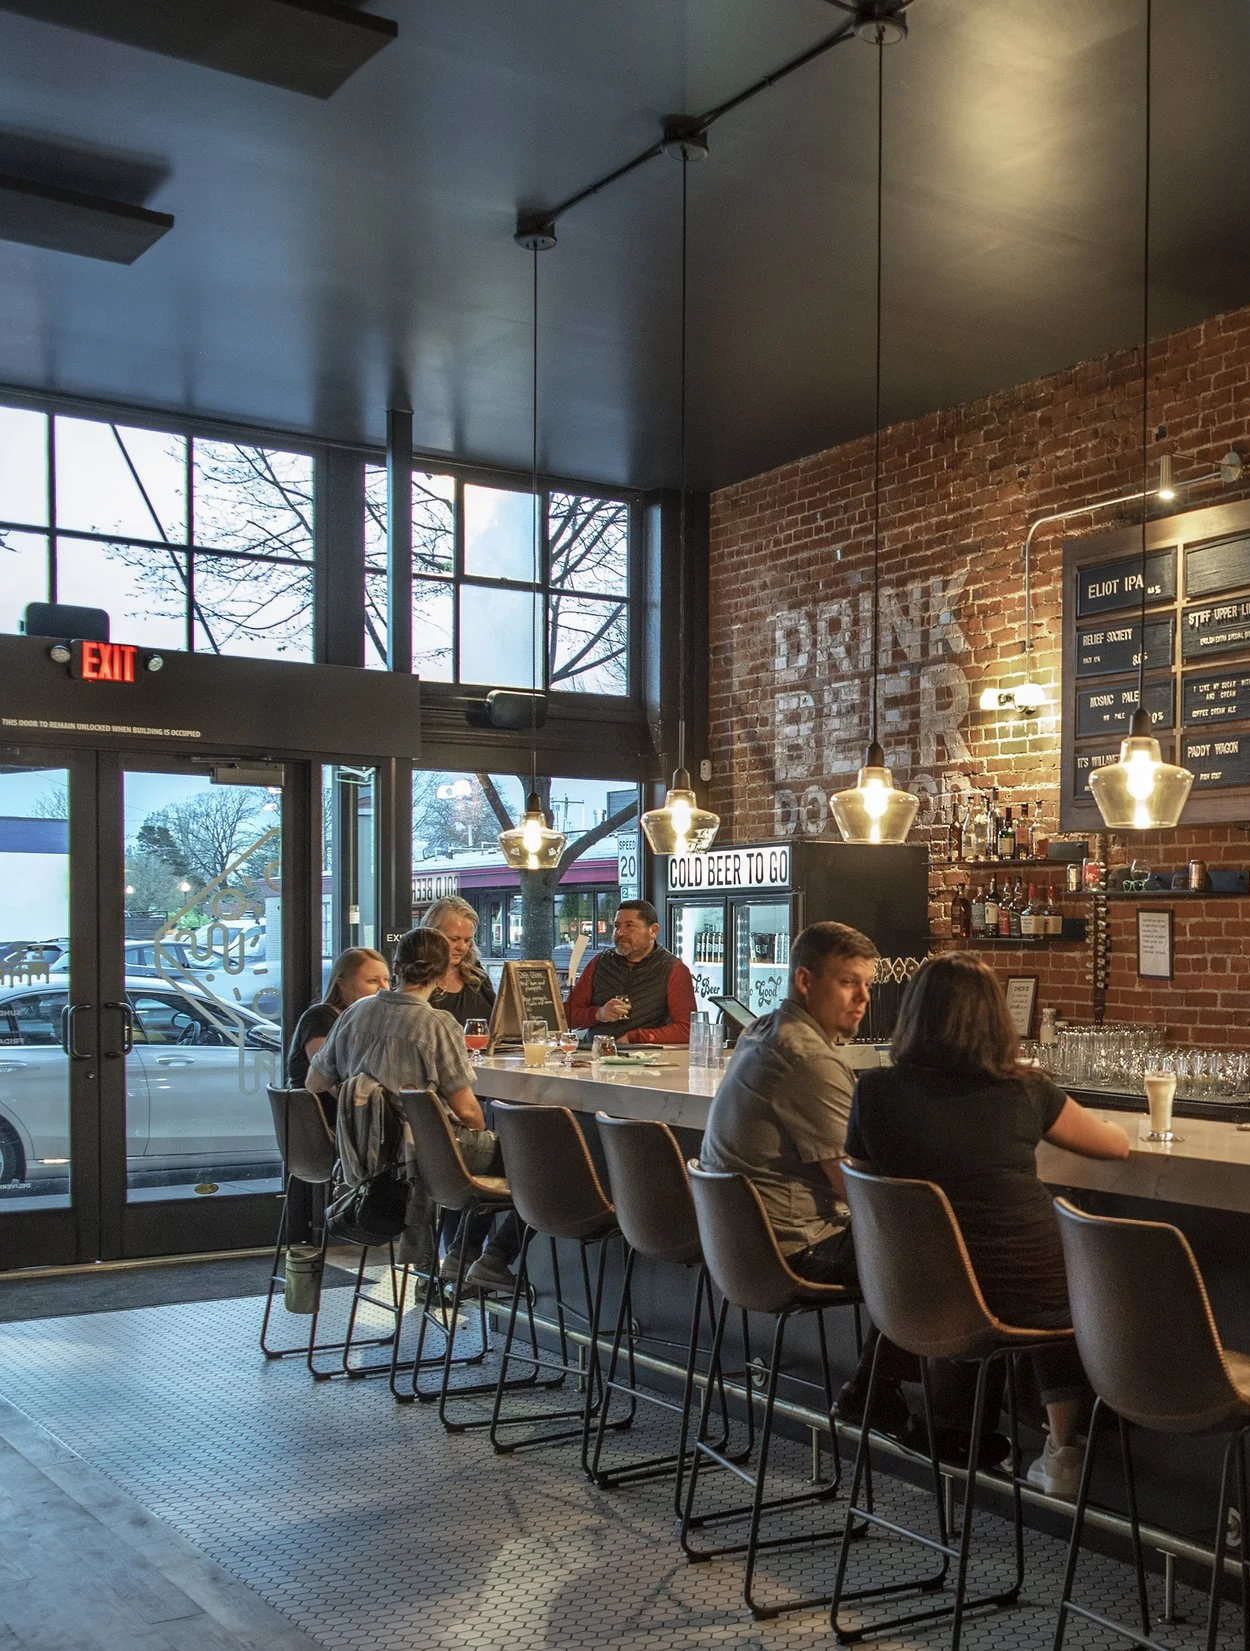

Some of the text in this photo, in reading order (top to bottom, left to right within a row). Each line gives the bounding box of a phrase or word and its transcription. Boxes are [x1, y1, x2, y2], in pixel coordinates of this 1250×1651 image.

[1088, 574, 1144, 599] ELIOT IPA
[775, 569, 975, 685] DRINK
[1188, 610, 1211, 628] STIFF
[1214, 605, 1237, 620] UPPER
[1083, 628, 1133, 647] RELIEF SOCIETY
[82, 641, 137, 683] EXIT
[1199, 683, 1210, 692] LIKE
[1213, 682, 1220, 690] MY
[1220, 690, 1236, 699] CREAM
[1090, 690, 1140, 708] MOSAIC PALE
[775, 662, 973, 781] BEER
[1191, 705, 1237, 718] COFFEE CREAM ALE
[2, 718, 201, 738] THIS DOOR TO REMAIN UNLOCKED WHEN BUILDING IS OCCUPIED
[1187, 741, 1239, 758] PADDY WAGON
[774, 784, 828, 836] DO
[618, 839, 636, 851] SPEED
[620, 855, 636, 878] 20
[670, 850, 788, 888] COLD BEER TO GO
[701, 977, 721, 998] Beer
[755, 976, 782, 1007] Good
